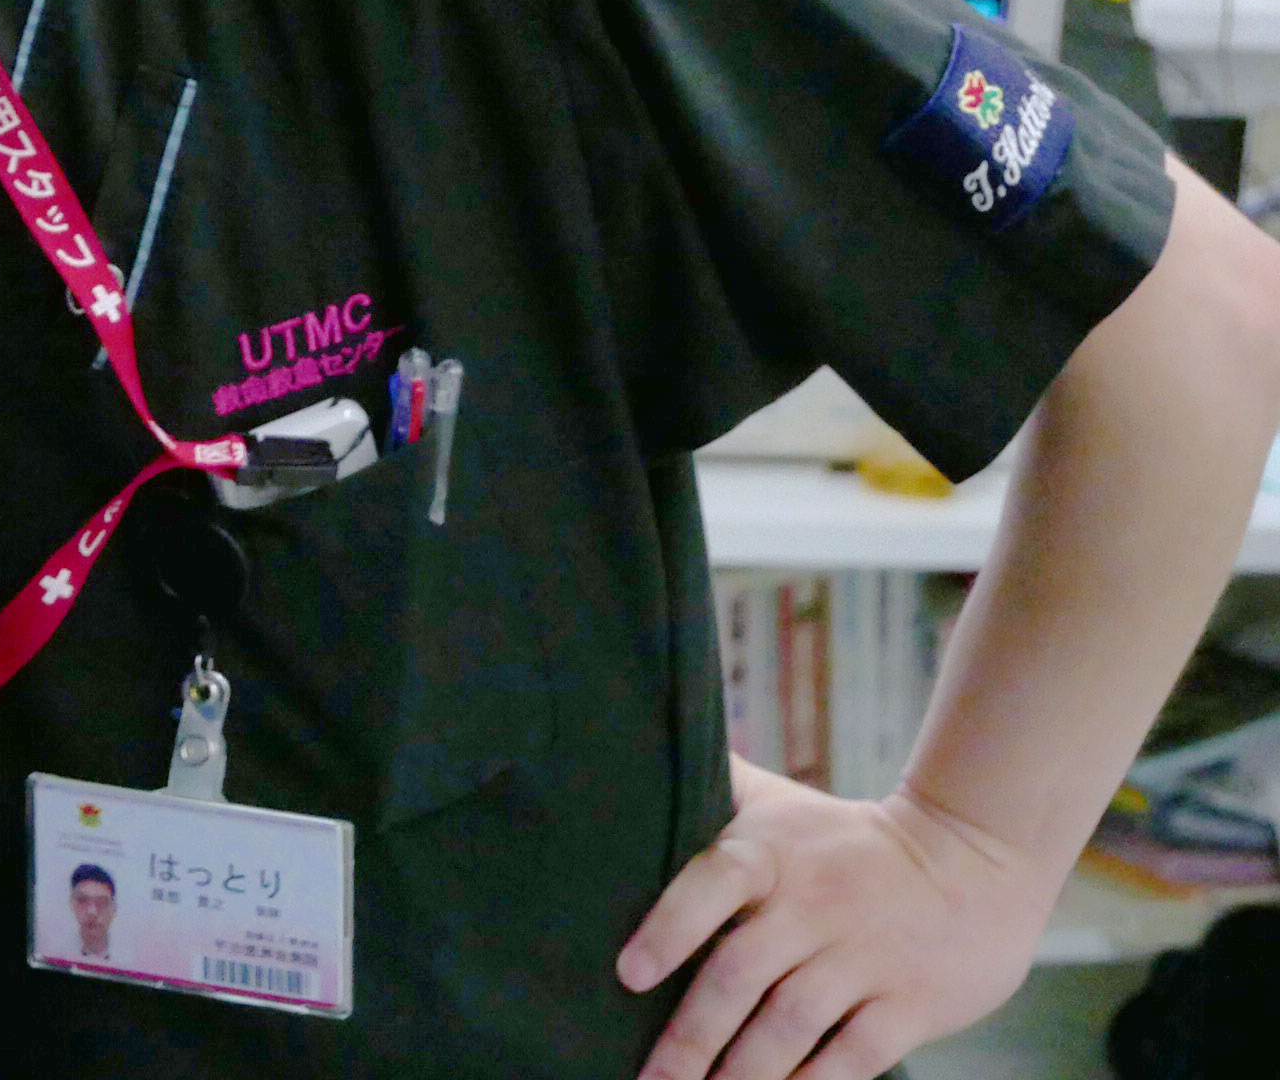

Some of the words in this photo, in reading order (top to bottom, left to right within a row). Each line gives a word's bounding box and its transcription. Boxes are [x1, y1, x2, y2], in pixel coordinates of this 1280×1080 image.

[237, 291, 373, 372] UTMC
[149, 852, 281, 899] はっとり
